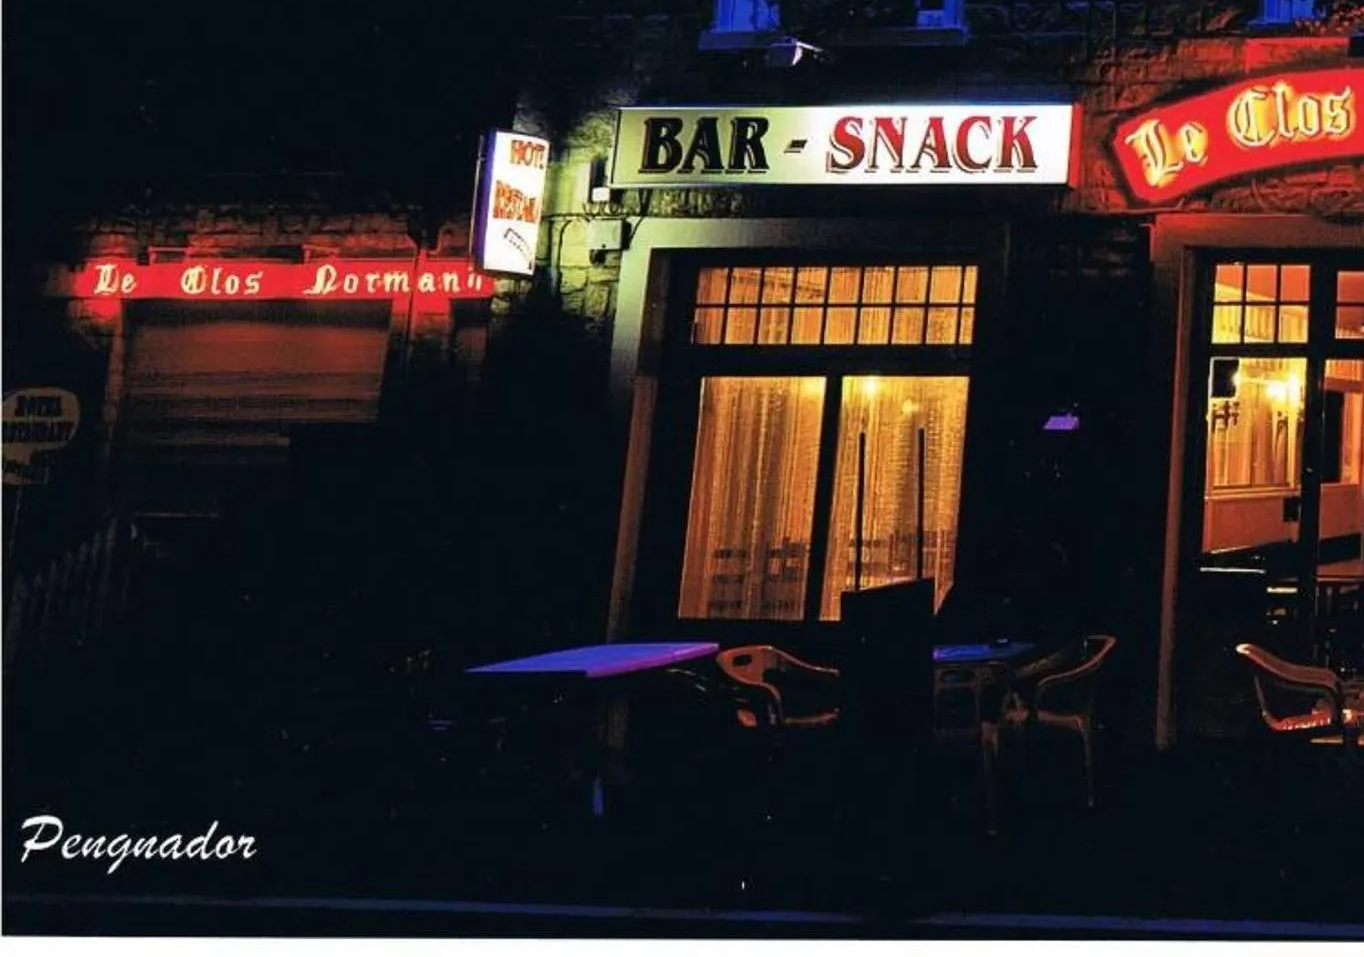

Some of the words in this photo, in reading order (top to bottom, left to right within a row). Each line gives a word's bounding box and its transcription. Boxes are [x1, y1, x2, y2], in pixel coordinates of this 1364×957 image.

[638, 116, 770, 175] BAR
[825, 115, 1037, 174] SNACK
[1126, 118, 1207, 186] Le
[1228, 80, 1352, 148] Clos
[94, 263, 137, 296] Le
[180, 265, 263, 296] Clos
